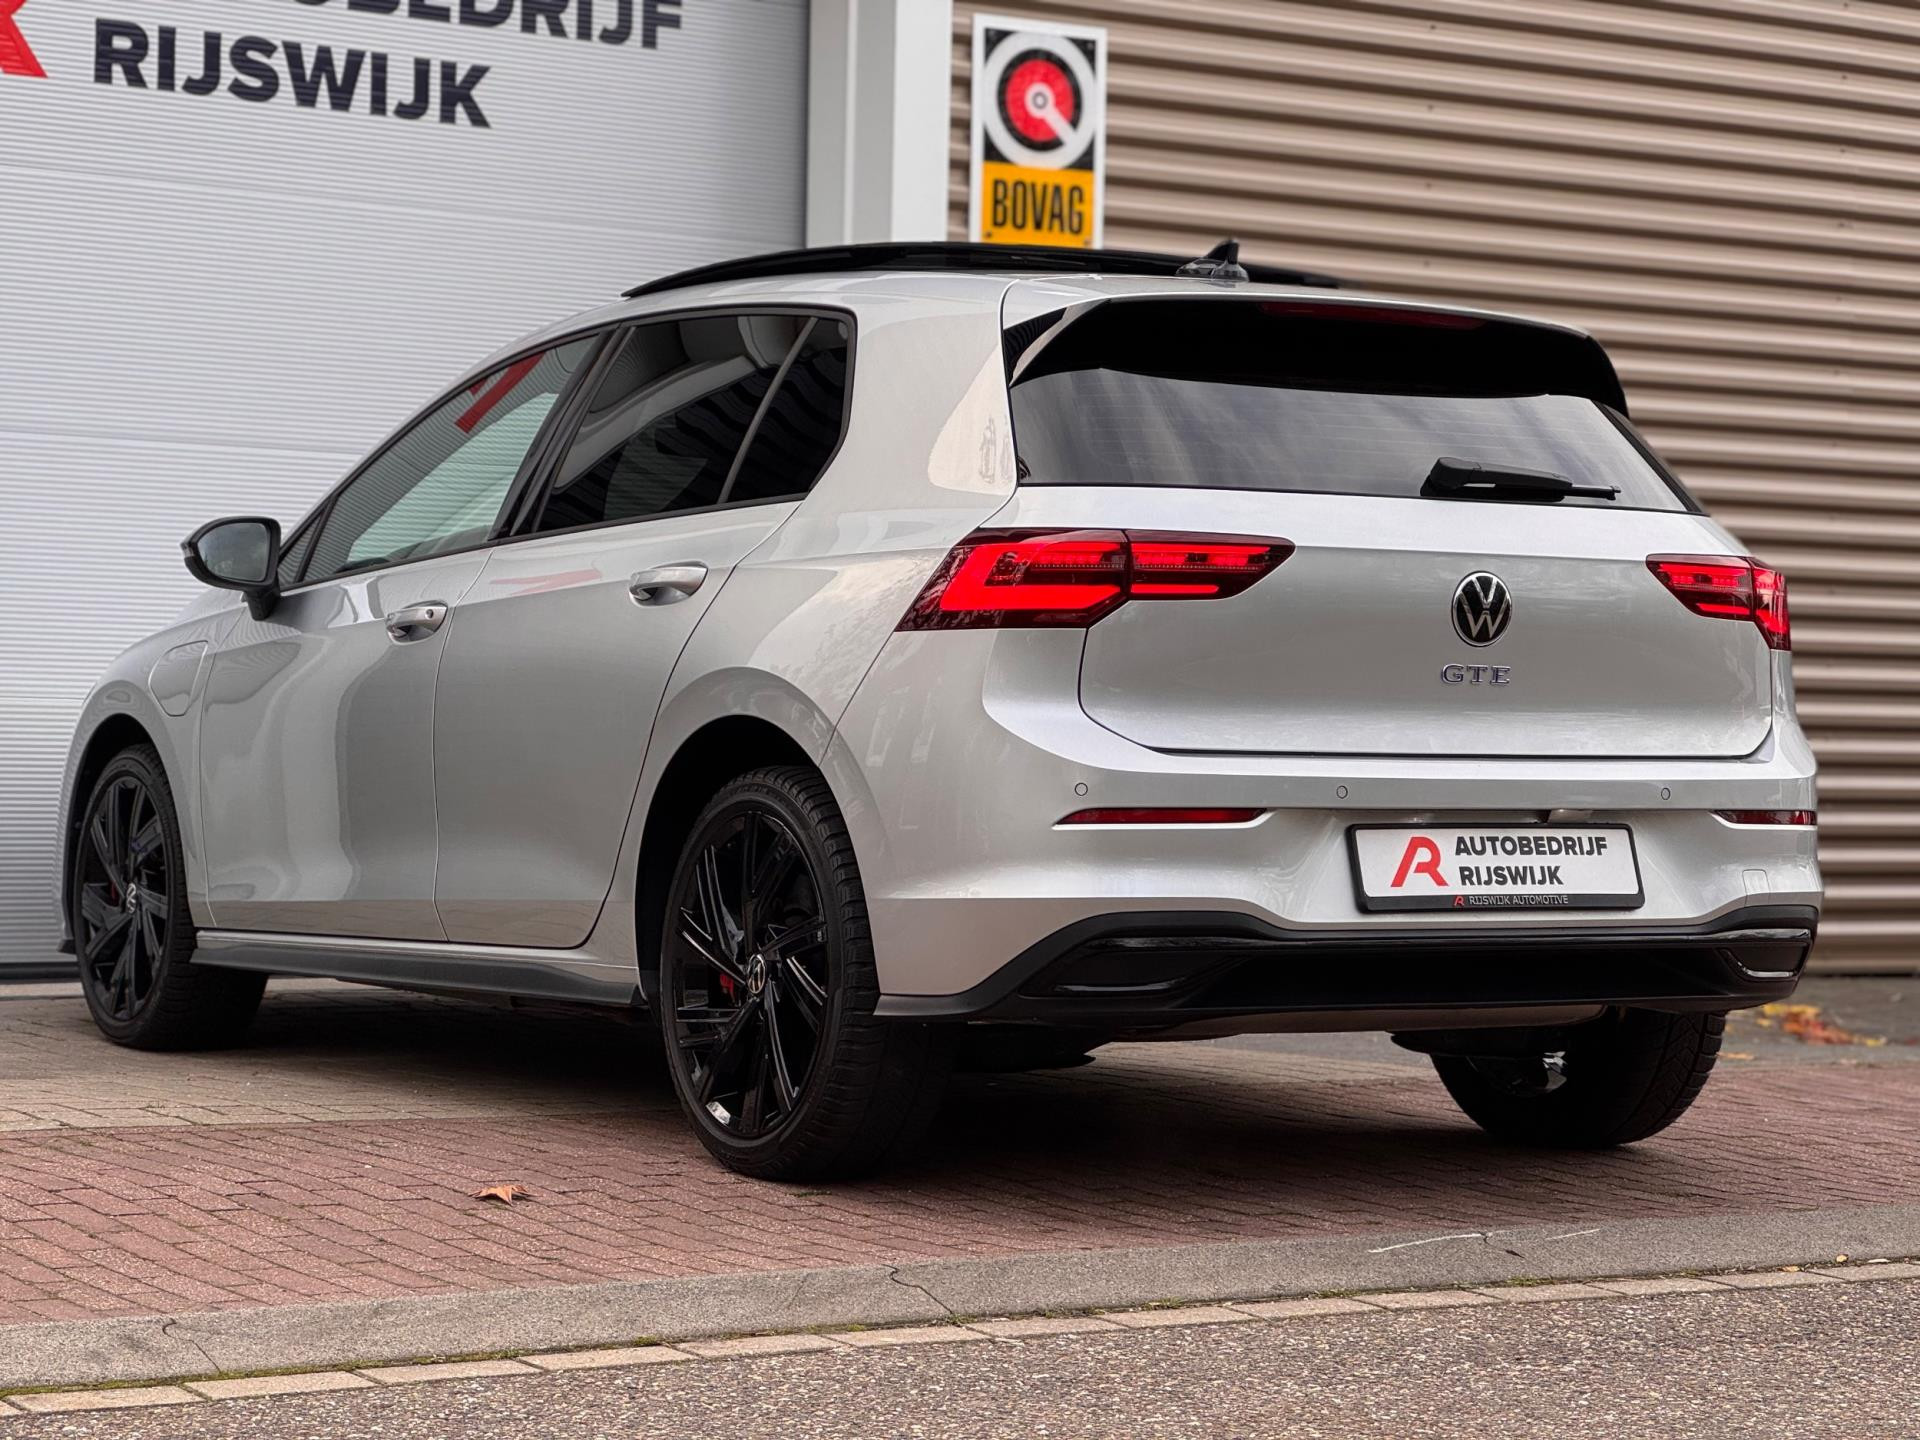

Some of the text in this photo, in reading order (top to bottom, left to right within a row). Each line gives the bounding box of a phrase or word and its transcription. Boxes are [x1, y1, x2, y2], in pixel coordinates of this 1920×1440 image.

[293, 0, 683, 49] RIJF
[94, 18, 491, 129] RIJSWIJK
[992, 179, 1084, 236] BOVAG
[1441, 663, 1511, 685] GTE
[1455, 836, 1608, 856] AUTOBEDRIJF
[1459, 865, 1563, 886] RIJSWIJK
[1469, 895, 1511, 905] RIJSWIJK
[1512, 894, 1569, 905] AUTOMOTIVE
